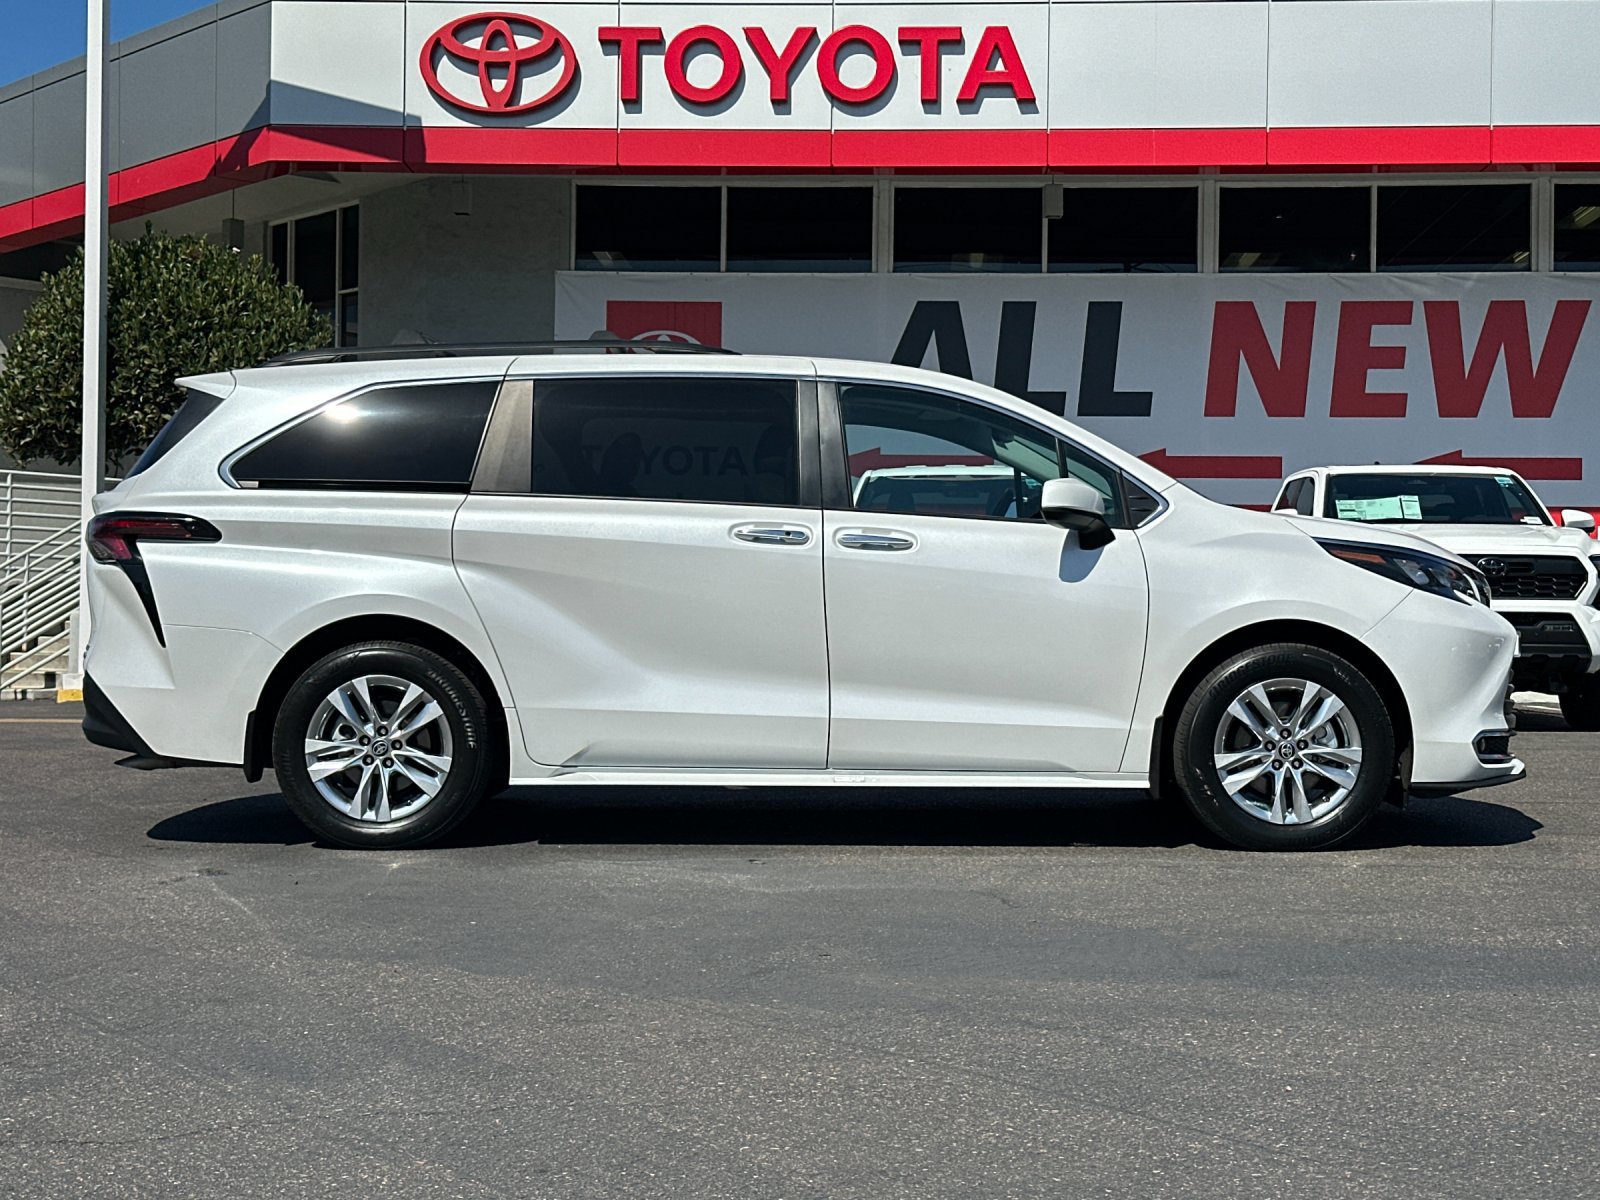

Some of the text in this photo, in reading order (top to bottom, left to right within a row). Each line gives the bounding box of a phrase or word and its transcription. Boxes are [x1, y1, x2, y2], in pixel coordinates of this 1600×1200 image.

[598, 24, 1037, 103] TOYOTA
[890, 300, 1592, 418] ALL NEW
[582, 444, 749, 476] TYOTA
[427, 670, 479, 750] BRIDGESTONE
